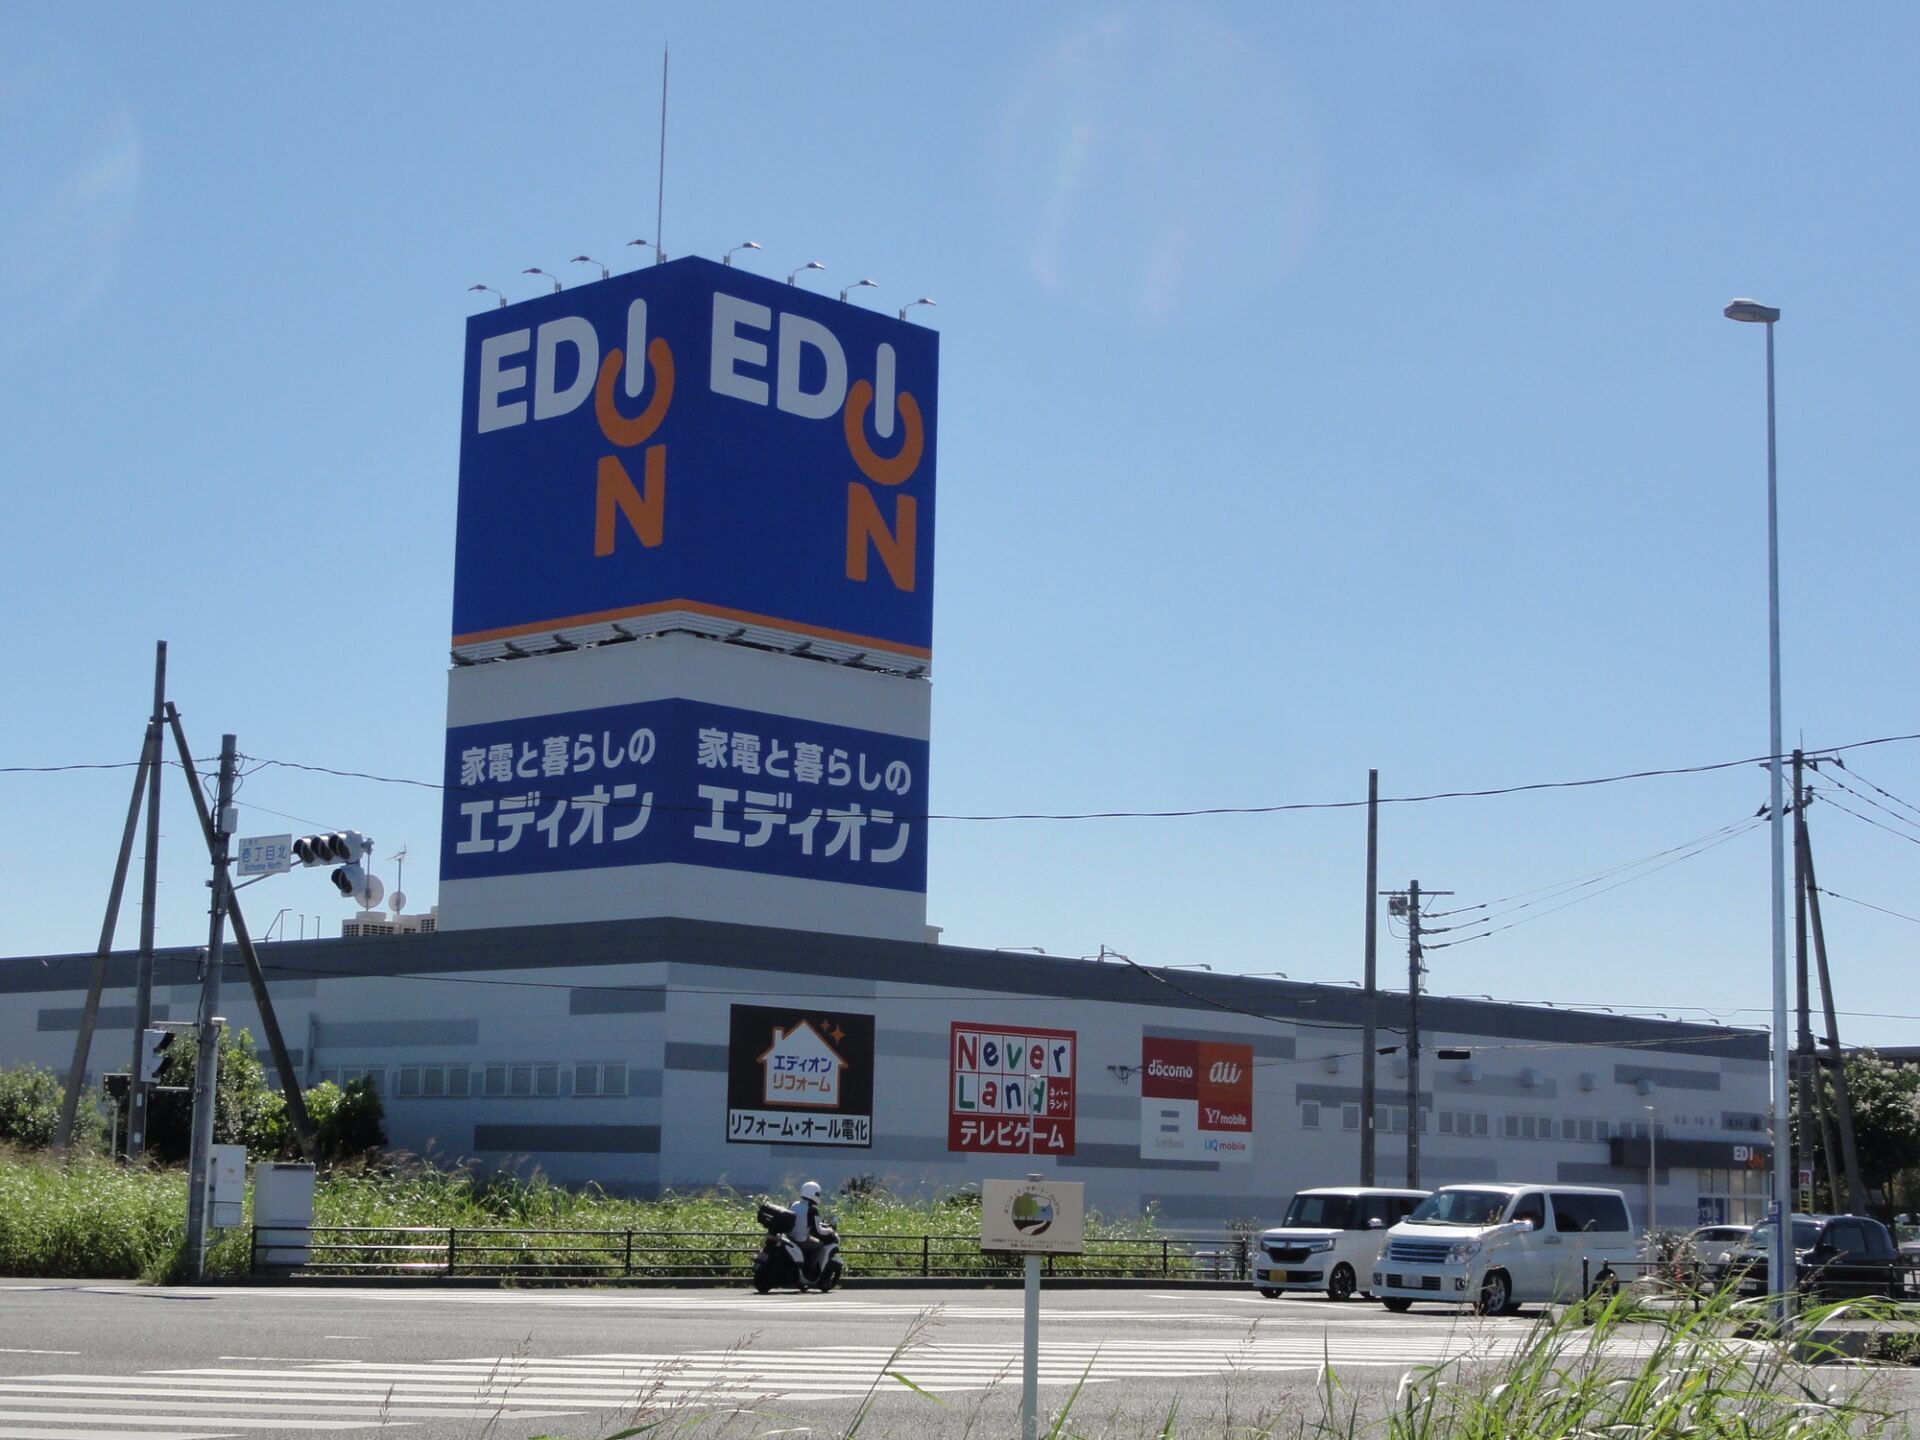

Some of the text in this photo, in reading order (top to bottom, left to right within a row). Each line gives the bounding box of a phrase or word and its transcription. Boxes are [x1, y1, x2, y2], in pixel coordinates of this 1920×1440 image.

[460, 728, 656, 786] 家電と暮らしの
[697, 727, 911, 796] 家電と暮らしの
[456, 783, 653, 855] エディオン
[694, 784, 910, 863] エディオン
[773, 1055, 832, 1073] エディオン
[958, 1035, 1066, 1073] Never
[1148, 1059, 1193, 1078] docomo
[1209, 1061, 1242, 1084] au
[773, 1074, 831, 1092] リフォーム
[1049, 1087, 1069, 1098] ネバー
[1049, 1099, 1068, 1111] ランド
[731, 1114, 868, 1141] リフォーム・オール電化
[960, 1121, 1065, 1149] テレビゲーム
[1204, 1139, 1246, 1152] UQ mobile
